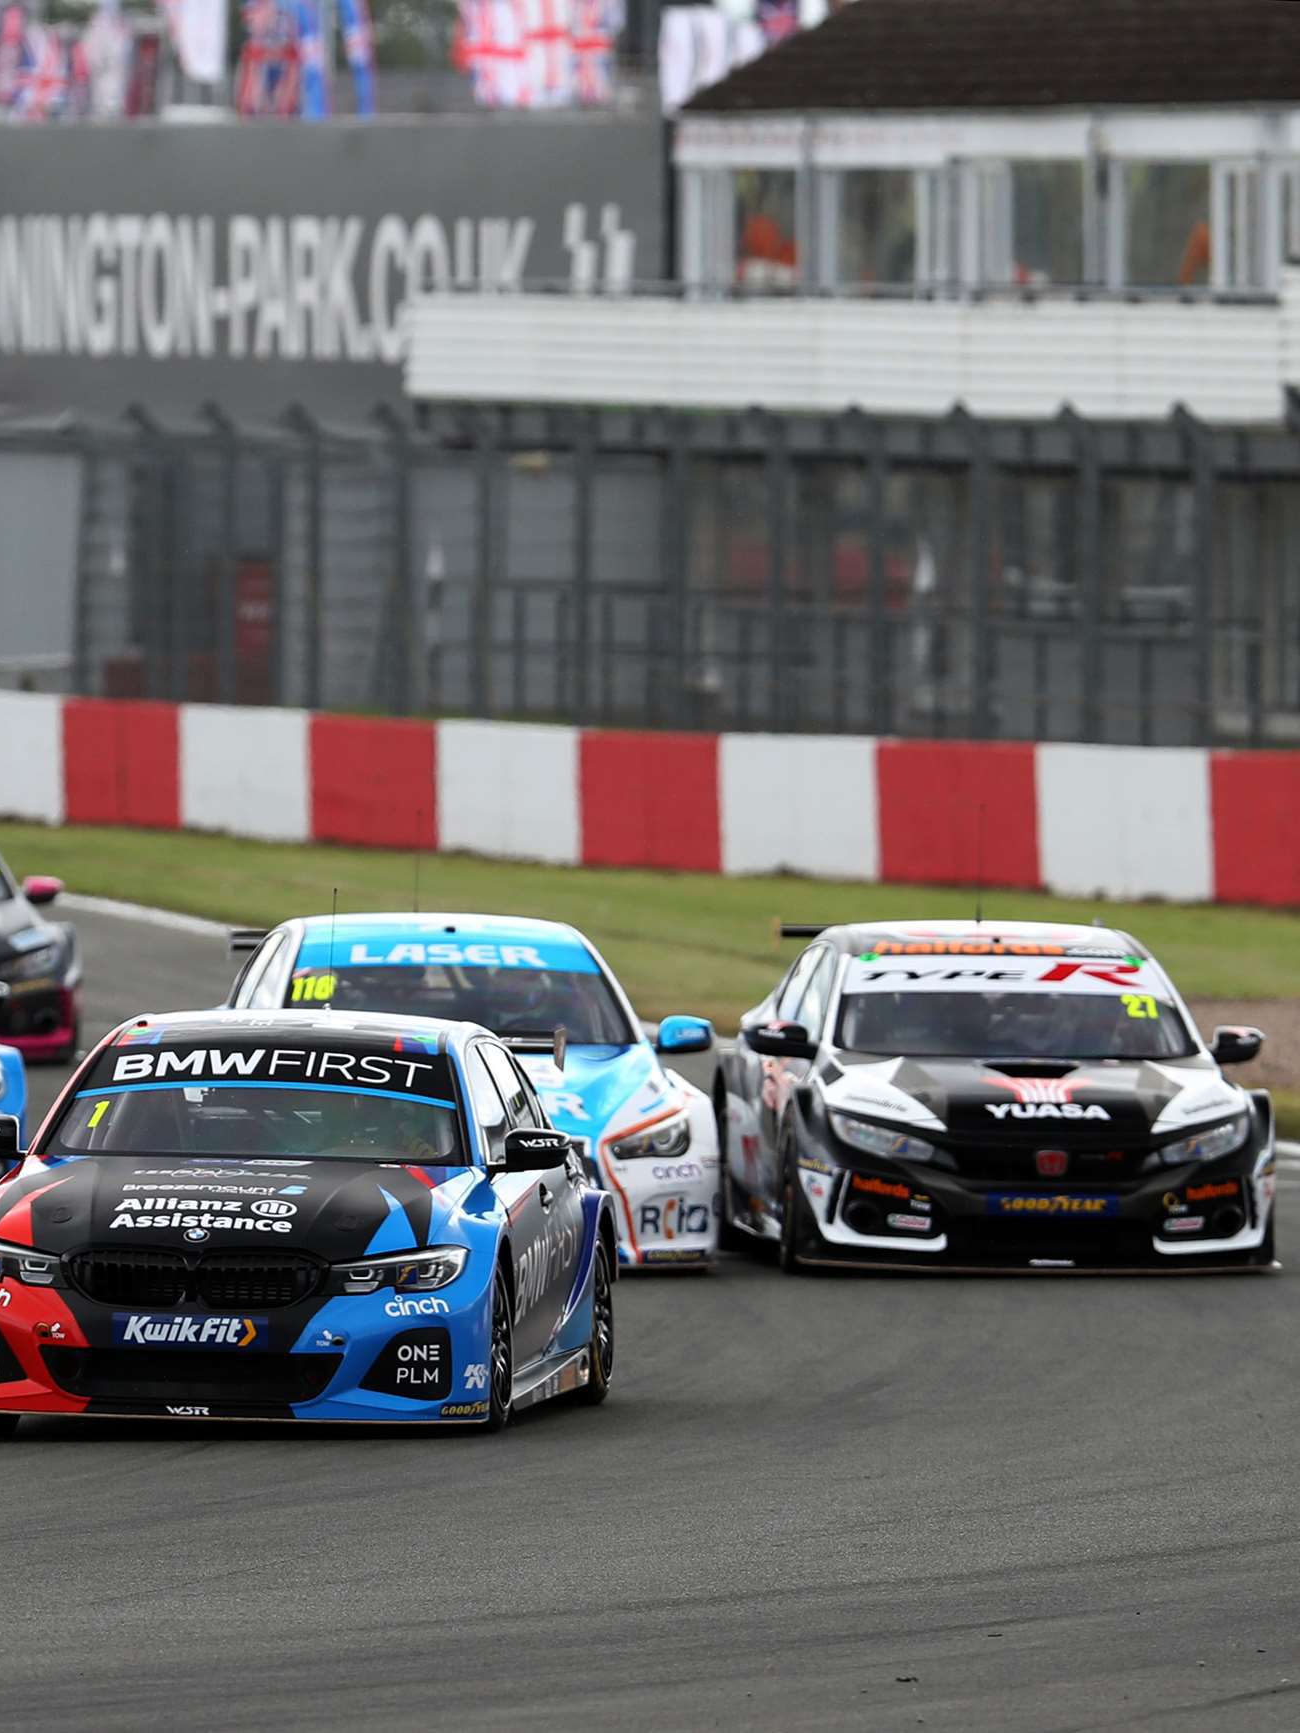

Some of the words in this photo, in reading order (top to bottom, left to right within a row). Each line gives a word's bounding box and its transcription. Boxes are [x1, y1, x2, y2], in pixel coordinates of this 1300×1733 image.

[350, 944, 548, 967] LASER
[861, 968, 1026, 981] TYPE
[1037, 962, 1145, 988] R
[1120, 994, 1158, 1019] 27
[87, 1101, 110, 1127] 1
[985, 1103, 1112, 1120] YUASA
[114, 1198, 243, 1212] Allianz
[109, 1212, 293, 1233] Assistance
[384, 1294, 449, 1317] cinch
[397, 1344, 440, 1362] ONE
[396, 1367, 439, 1384] PLM
